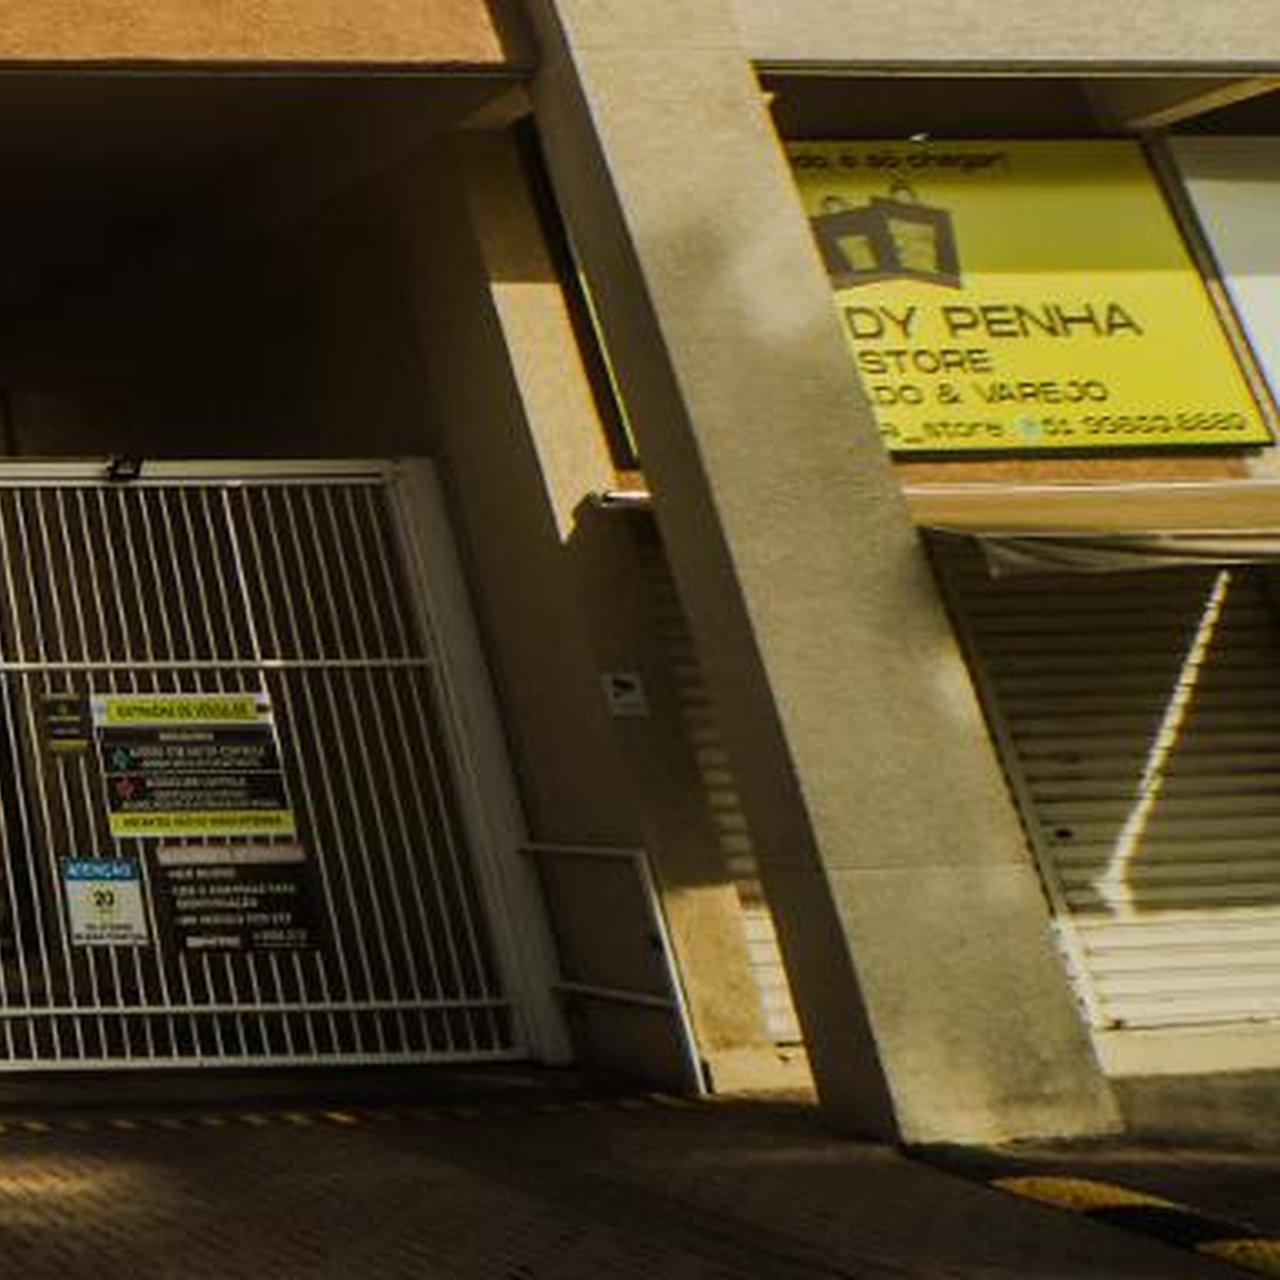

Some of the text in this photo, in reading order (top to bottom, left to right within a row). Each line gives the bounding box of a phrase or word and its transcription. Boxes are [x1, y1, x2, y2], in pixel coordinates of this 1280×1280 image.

[941, 303, 1145, 339] PENHA
[857, 348, 991, 374] STORE
[939, 382, 962, 405] &
[972, 380, 1109, 405] VAREJO
